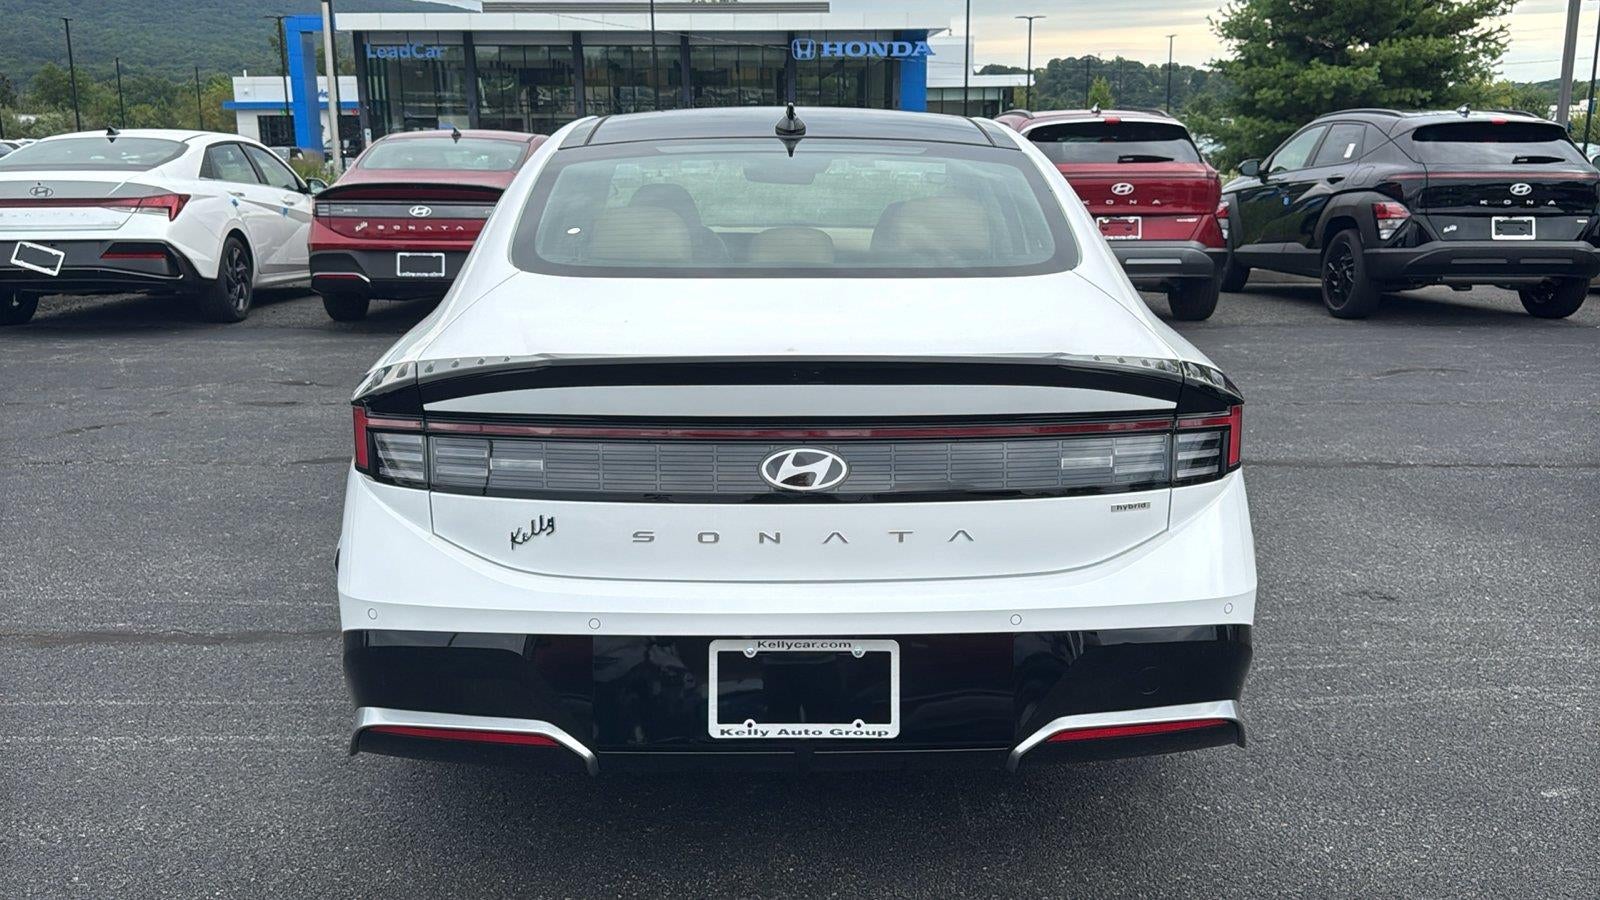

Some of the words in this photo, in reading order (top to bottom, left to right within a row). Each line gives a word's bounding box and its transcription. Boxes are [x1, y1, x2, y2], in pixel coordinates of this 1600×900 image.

[366, 41, 447, 59] LeadCar
[820, 41, 936, 57] HONDA
[1116, 502, 1148, 511] hybrid
[510, 514, 555, 550] Kelly
[632, 529, 975, 545] SONATA
[757, 640, 851, 650] Kellycar.com
[719, 728, 770, 737] Kelly
[777, 728, 823, 736] Auto
[829, 728, 889, 738] Group
